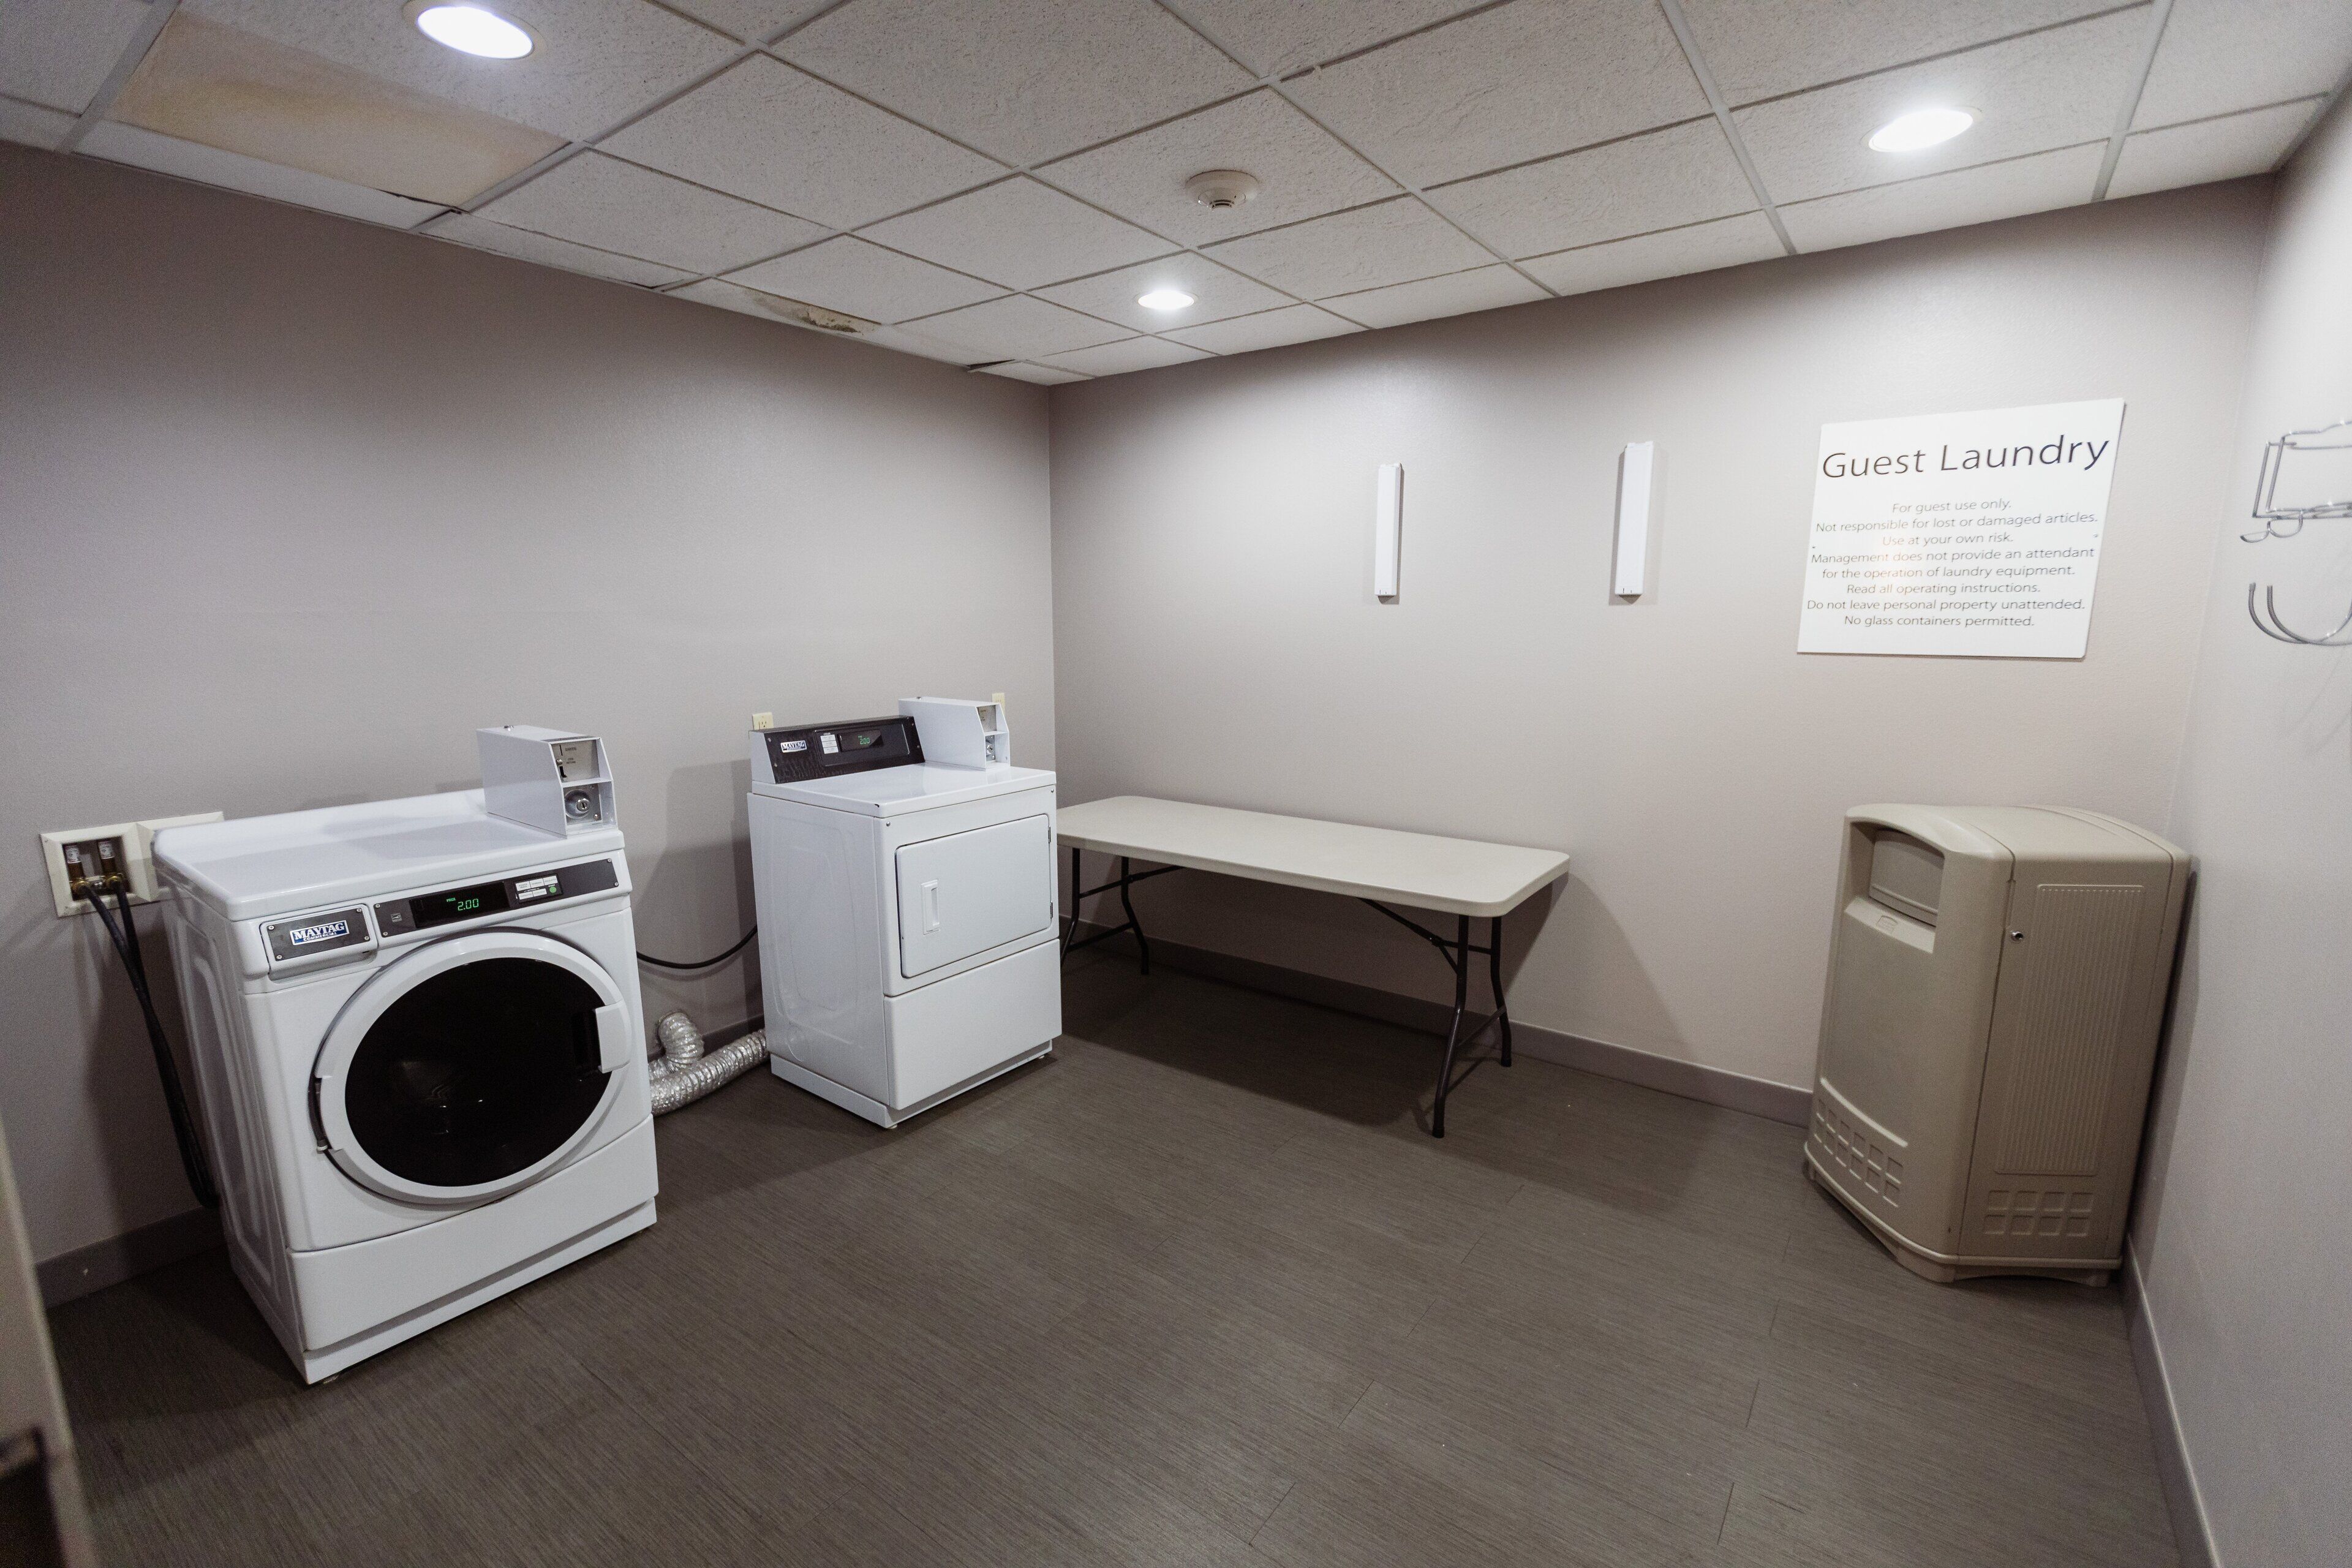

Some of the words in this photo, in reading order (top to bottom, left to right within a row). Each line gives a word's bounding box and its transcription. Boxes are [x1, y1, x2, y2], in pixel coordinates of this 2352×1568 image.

[1823, 450, 1926, 478] Guest
[1941, 434, 2109, 470] Laundry
[1893, 503, 1912, 513] For
[1916, 503, 1951, 514] guest
[1981, 498, 2011, 511] only.
[1816, 522, 1837, 532] Not
[1841, 519, 1908, 533] responsible
[1913, 518, 1929, 529] for
[1933, 518, 1956, 527] lost
[1977, 513, 2041, 527] damaged
[2045, 512, 2098, 524] articles.
[1883, 537, 1904, 545] Use
[1923, 537, 1951, 547] your
[1989, 532, 2013, 542] risk.
[1811, 554, 1890, 565] Management
[1893, 552, 1922, 561] does
[1926, 552, 1948, 560] not
[1951, 549, 2001, 562] provide
[2026, 547, 2095, 559] attendant
[1823, 568, 1838, 578] for
[1842, 568, 1860, 578] the
[1863, 568, 1923, 580] operation
[1927, 567, 1940, 576] of
[1943, 566, 1992, 578] laundry
[1996, 566, 2075, 578] equipment.
[1847, 584, 1875, 594] Read
[1880, 584, 1892, 593] all
[1897, 583, 1957, 595] operating
[1961, 583, 2040, 593] instructions.
[1807, 600, 1823, 609] Do
[1850, 600, 1880, 609] leave
[1883, 599, 1936, 611] personal
[1940, 601, 1997, 612] property
[2001, 599, 2085, 609] unattended.
[1845, 616, 1861, 625] No
[1864, 616, 1893, 627] glass
[1896, 616, 1961, 625] containers
[1965, 616, 2035, 628] permitted.
[782, 741, 805, 750] MAYTAG
[458, 899, 479, 911] 2.00
[293, 922, 345, 940] MAYTAG
[303, 932, 337, 941] COMMERCIAL
